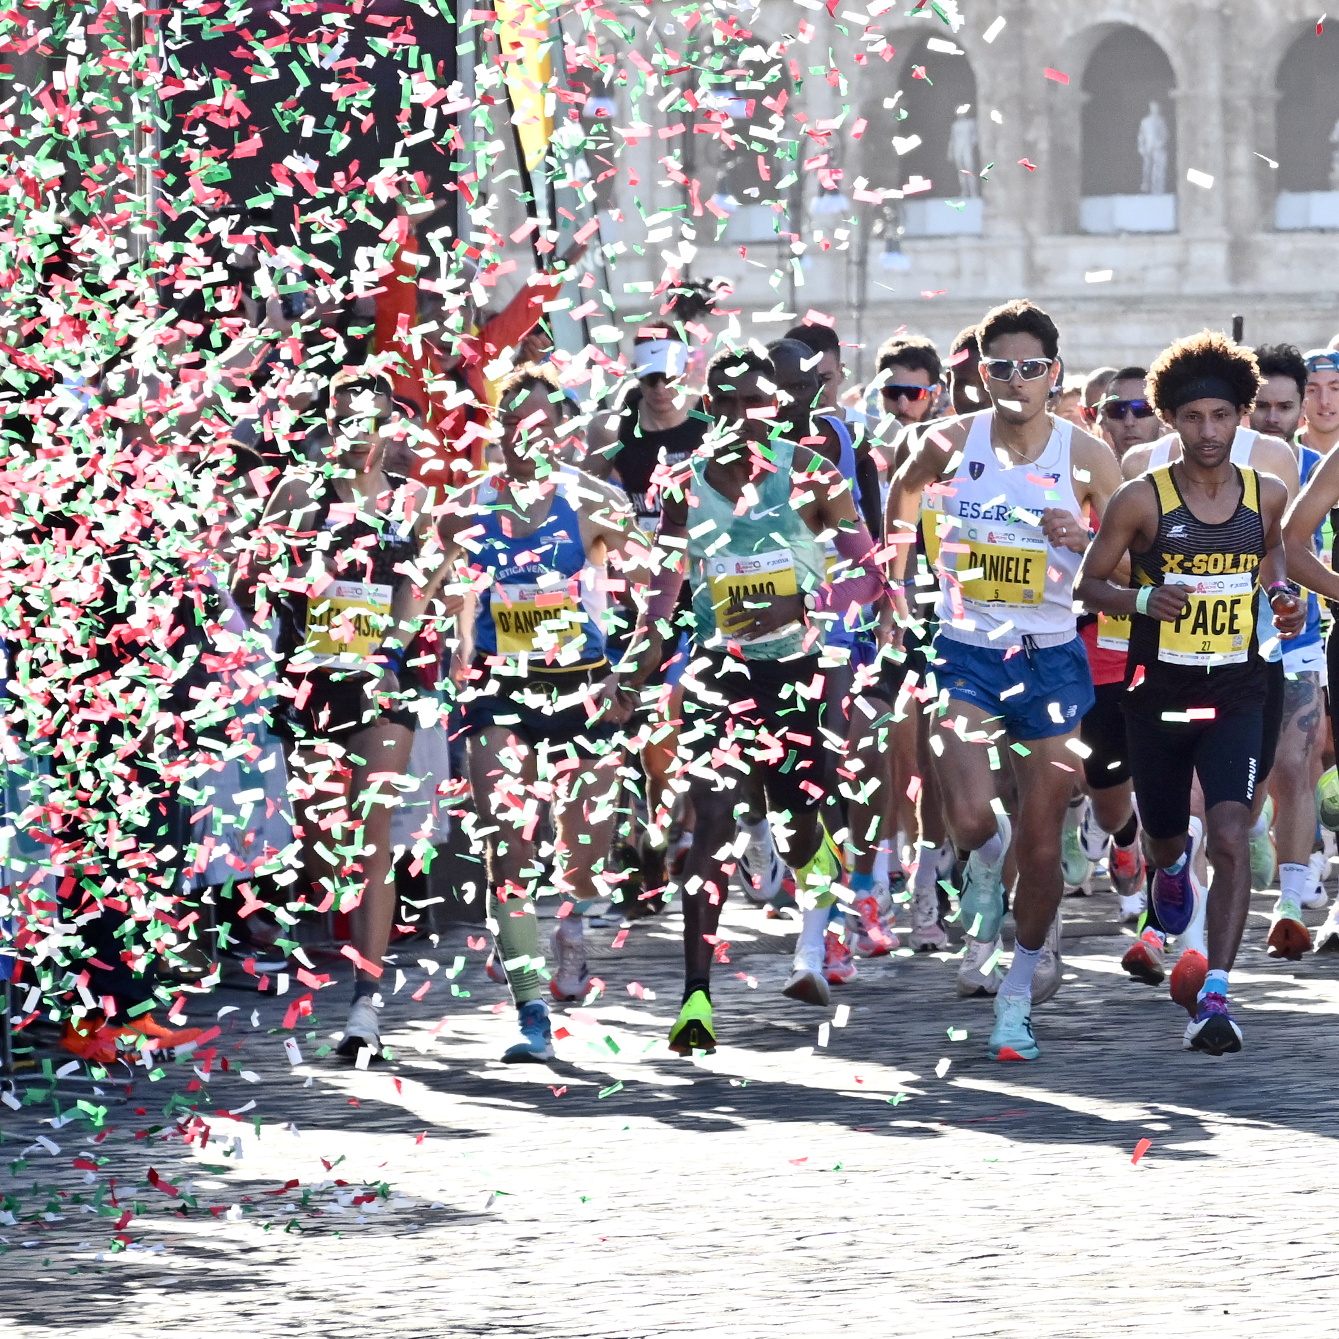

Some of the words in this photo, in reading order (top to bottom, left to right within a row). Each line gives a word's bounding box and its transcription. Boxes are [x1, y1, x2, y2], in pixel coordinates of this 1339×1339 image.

[969, 551, 1032, 584] DANIELE
[1161, 553, 1259, 574] X-SOLID
[994, 589, 999, 599] 5
[1174, 599, 1241, 636] PACE
[1202, 641, 1211, 651] 27
[1246, 757, 1257, 800] KIPRUN
